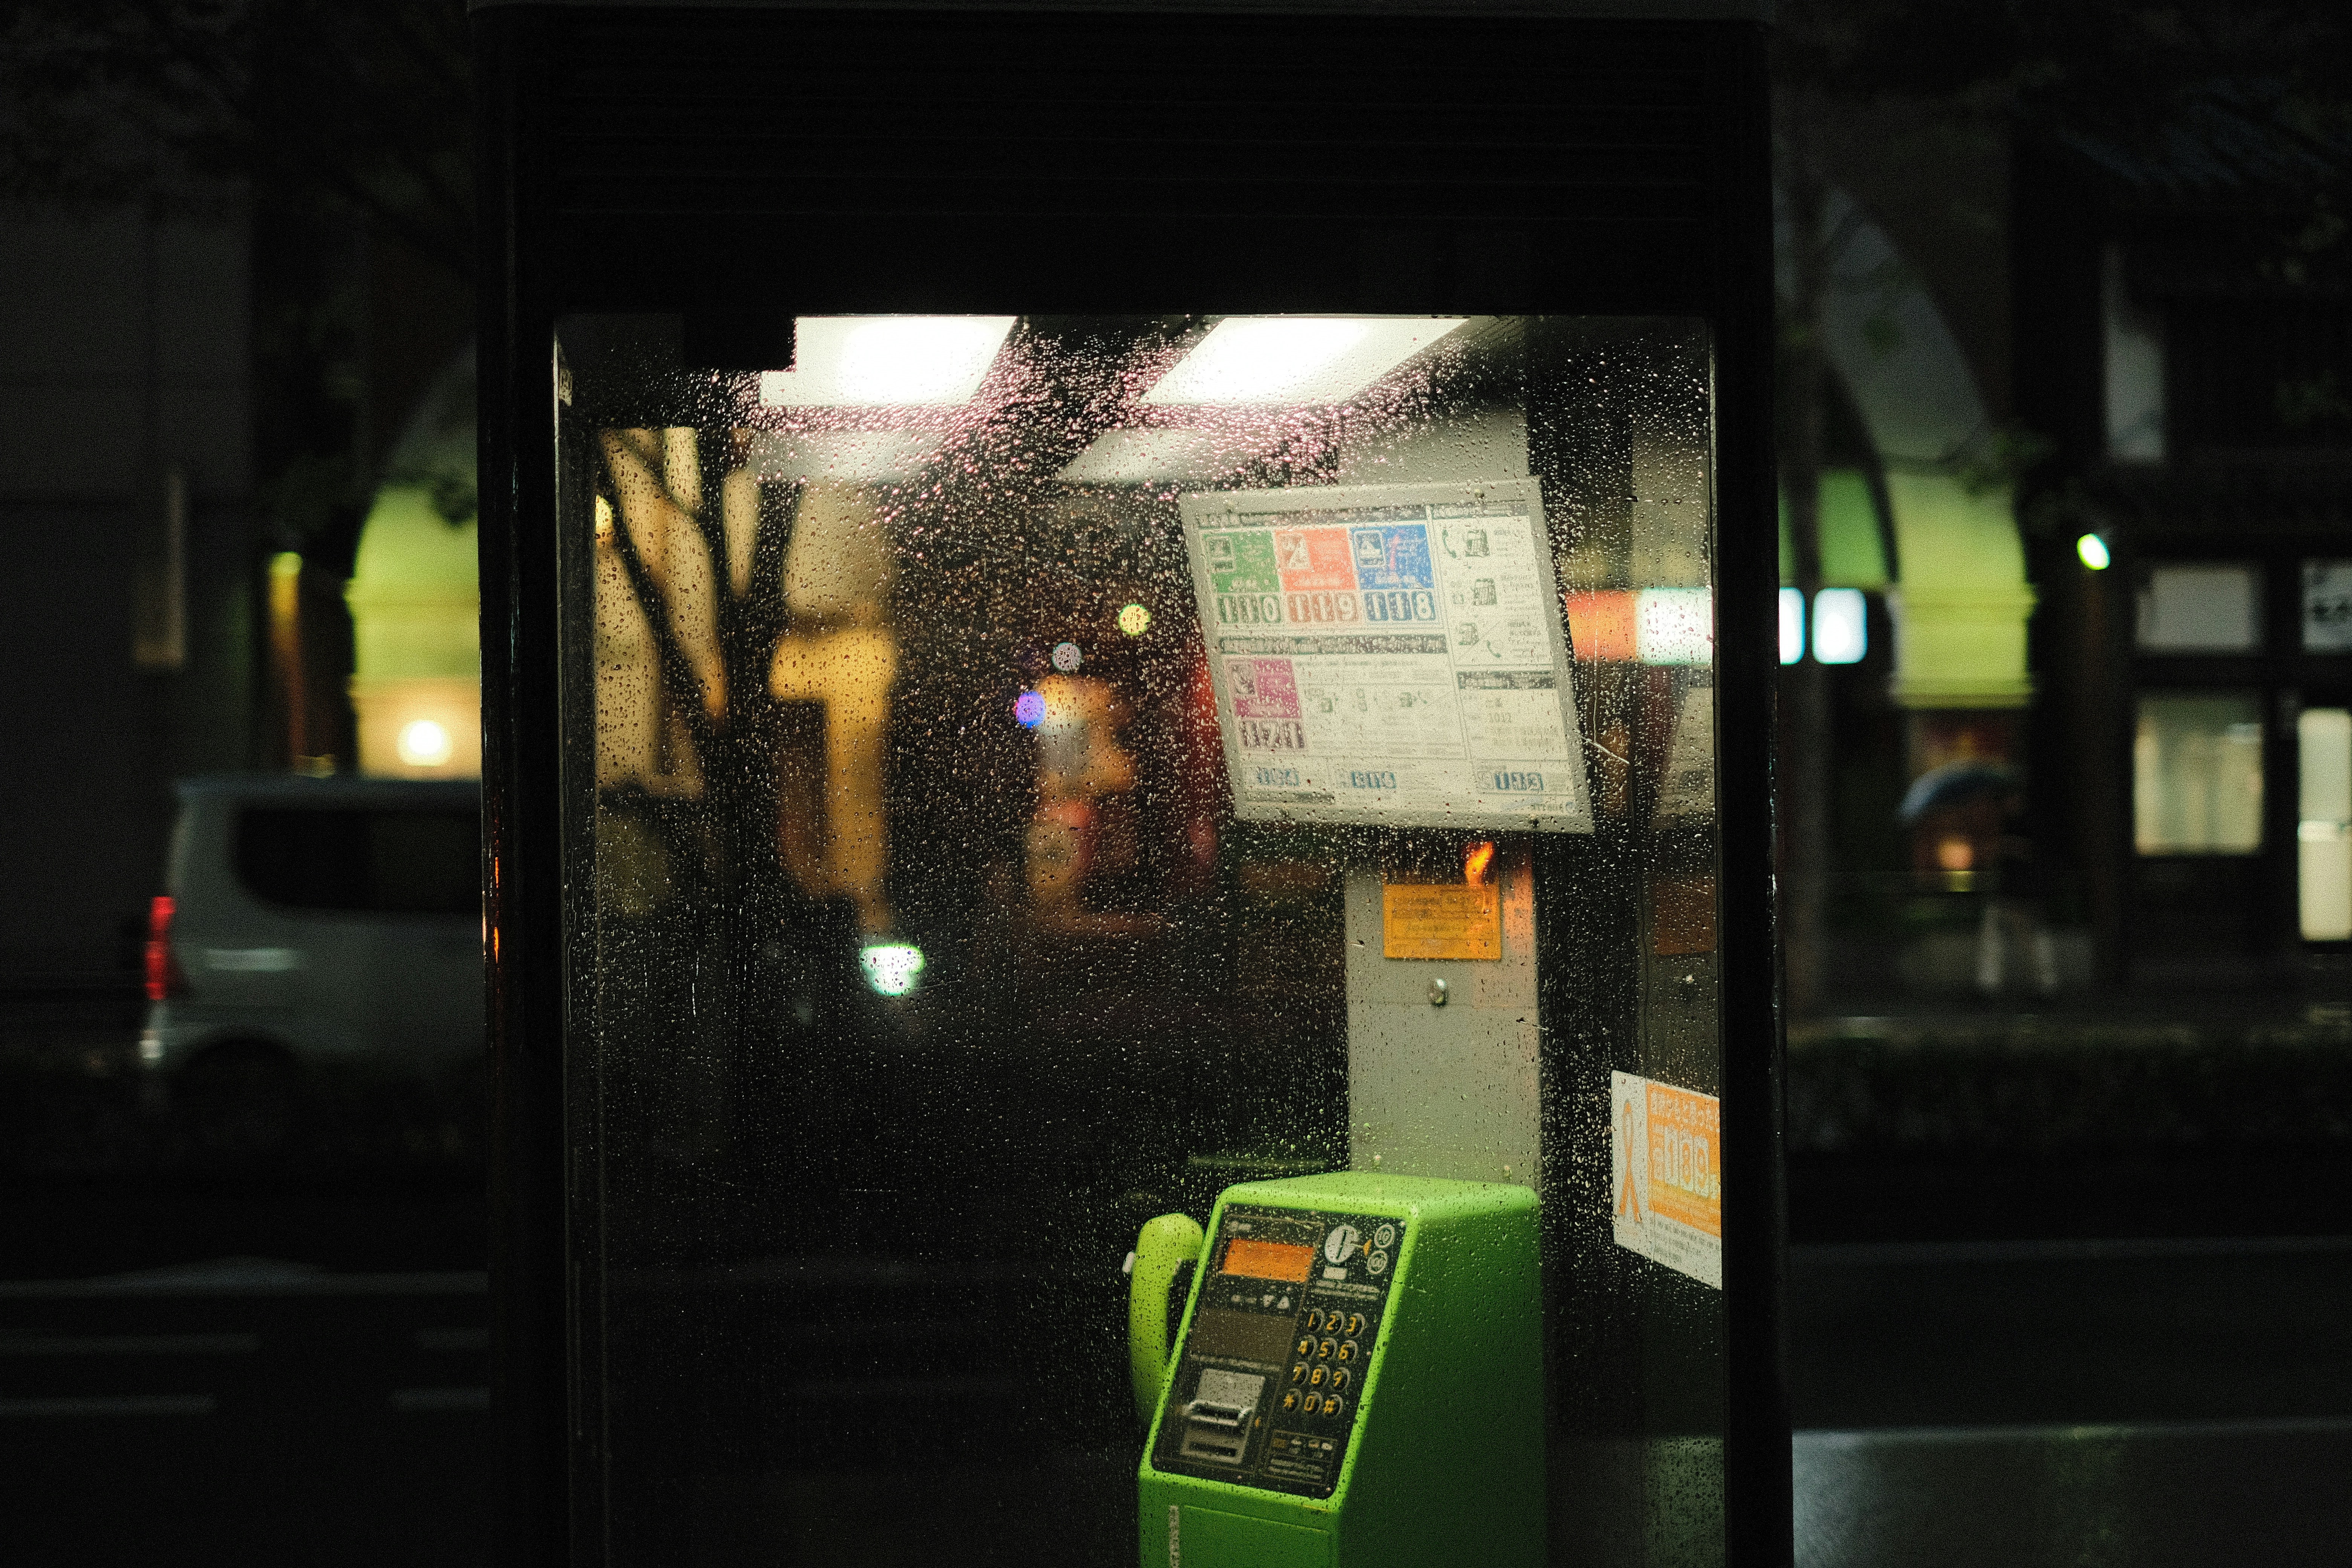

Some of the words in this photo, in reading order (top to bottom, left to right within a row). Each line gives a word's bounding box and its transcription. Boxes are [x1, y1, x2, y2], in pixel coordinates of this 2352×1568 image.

[1222, 593, 1279, 623] 110
[1294, 593, 1356, 622] 119
[1371, 592, 1433, 621] 118
[1244, 721, 1301, 749] 171
[1308, 1312, 1315, 1327] 1
[1326, 1314, 1337, 1331] 2
[1346, 1316, 1357, 1332] 3
[1298, 1340, 1308, 1355] 4
[1318, 1341, 1329, 1357] 5
[1338, 1344, 1349, 1360] 6
[1292, 1366, 1302, 1381] 7
[1311, 1368, 1322, 1384] 8
[1333, 1370, 1343, 1387] 9
[1304, 1396, 1315, 1411] 0
